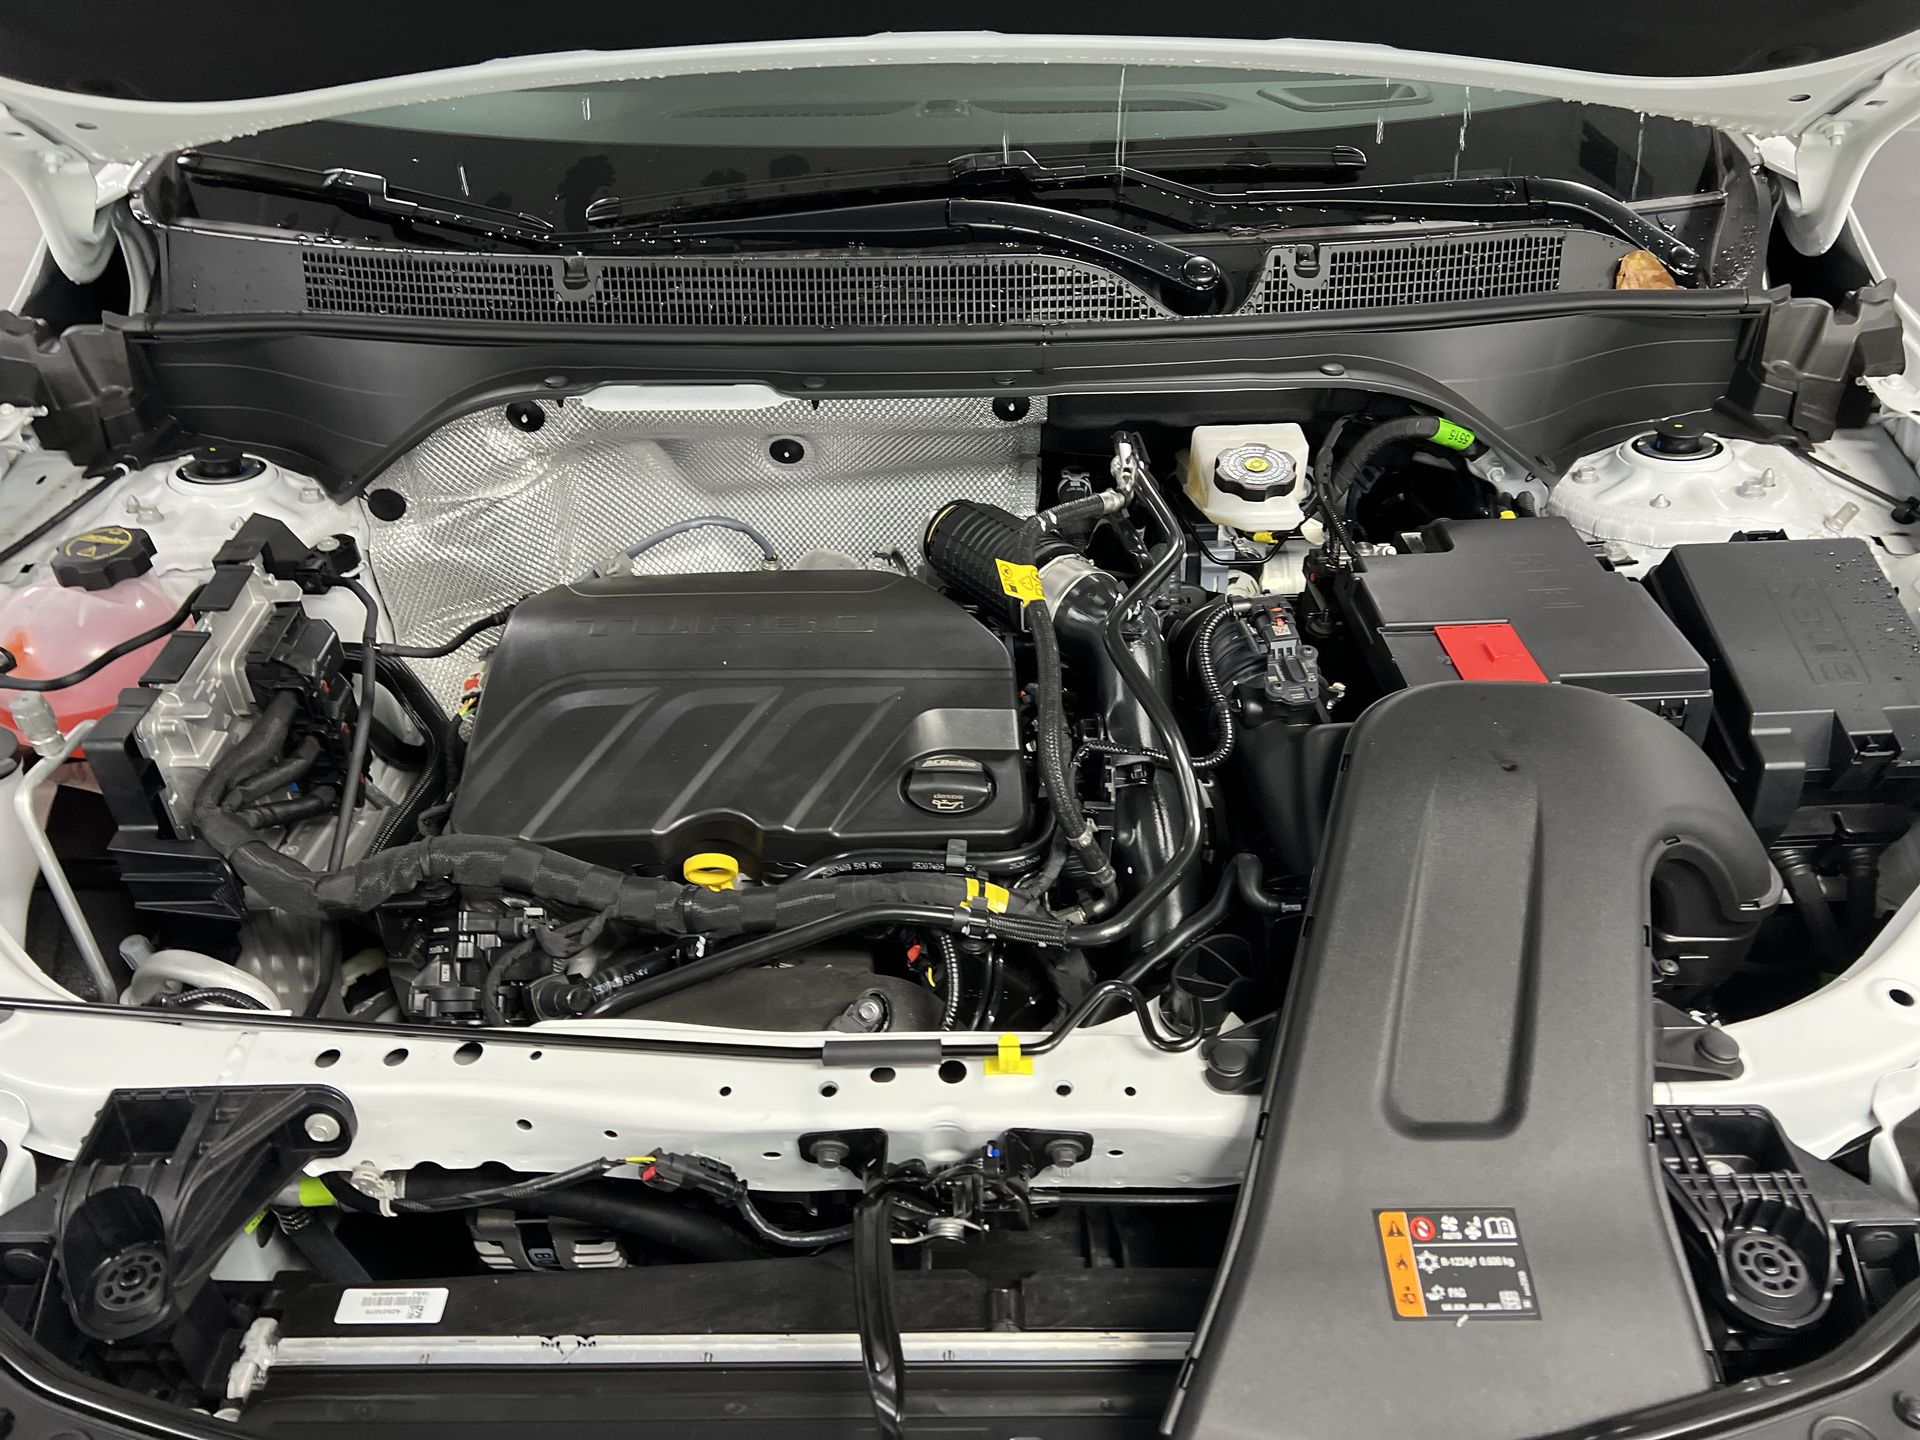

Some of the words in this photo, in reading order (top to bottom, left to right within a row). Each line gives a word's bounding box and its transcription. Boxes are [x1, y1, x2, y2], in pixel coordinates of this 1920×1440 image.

[1448, 429, 1471, 444] 5515
[575, 616, 878, 637] TURBO
[921, 759, 977, 768] ACDelco
